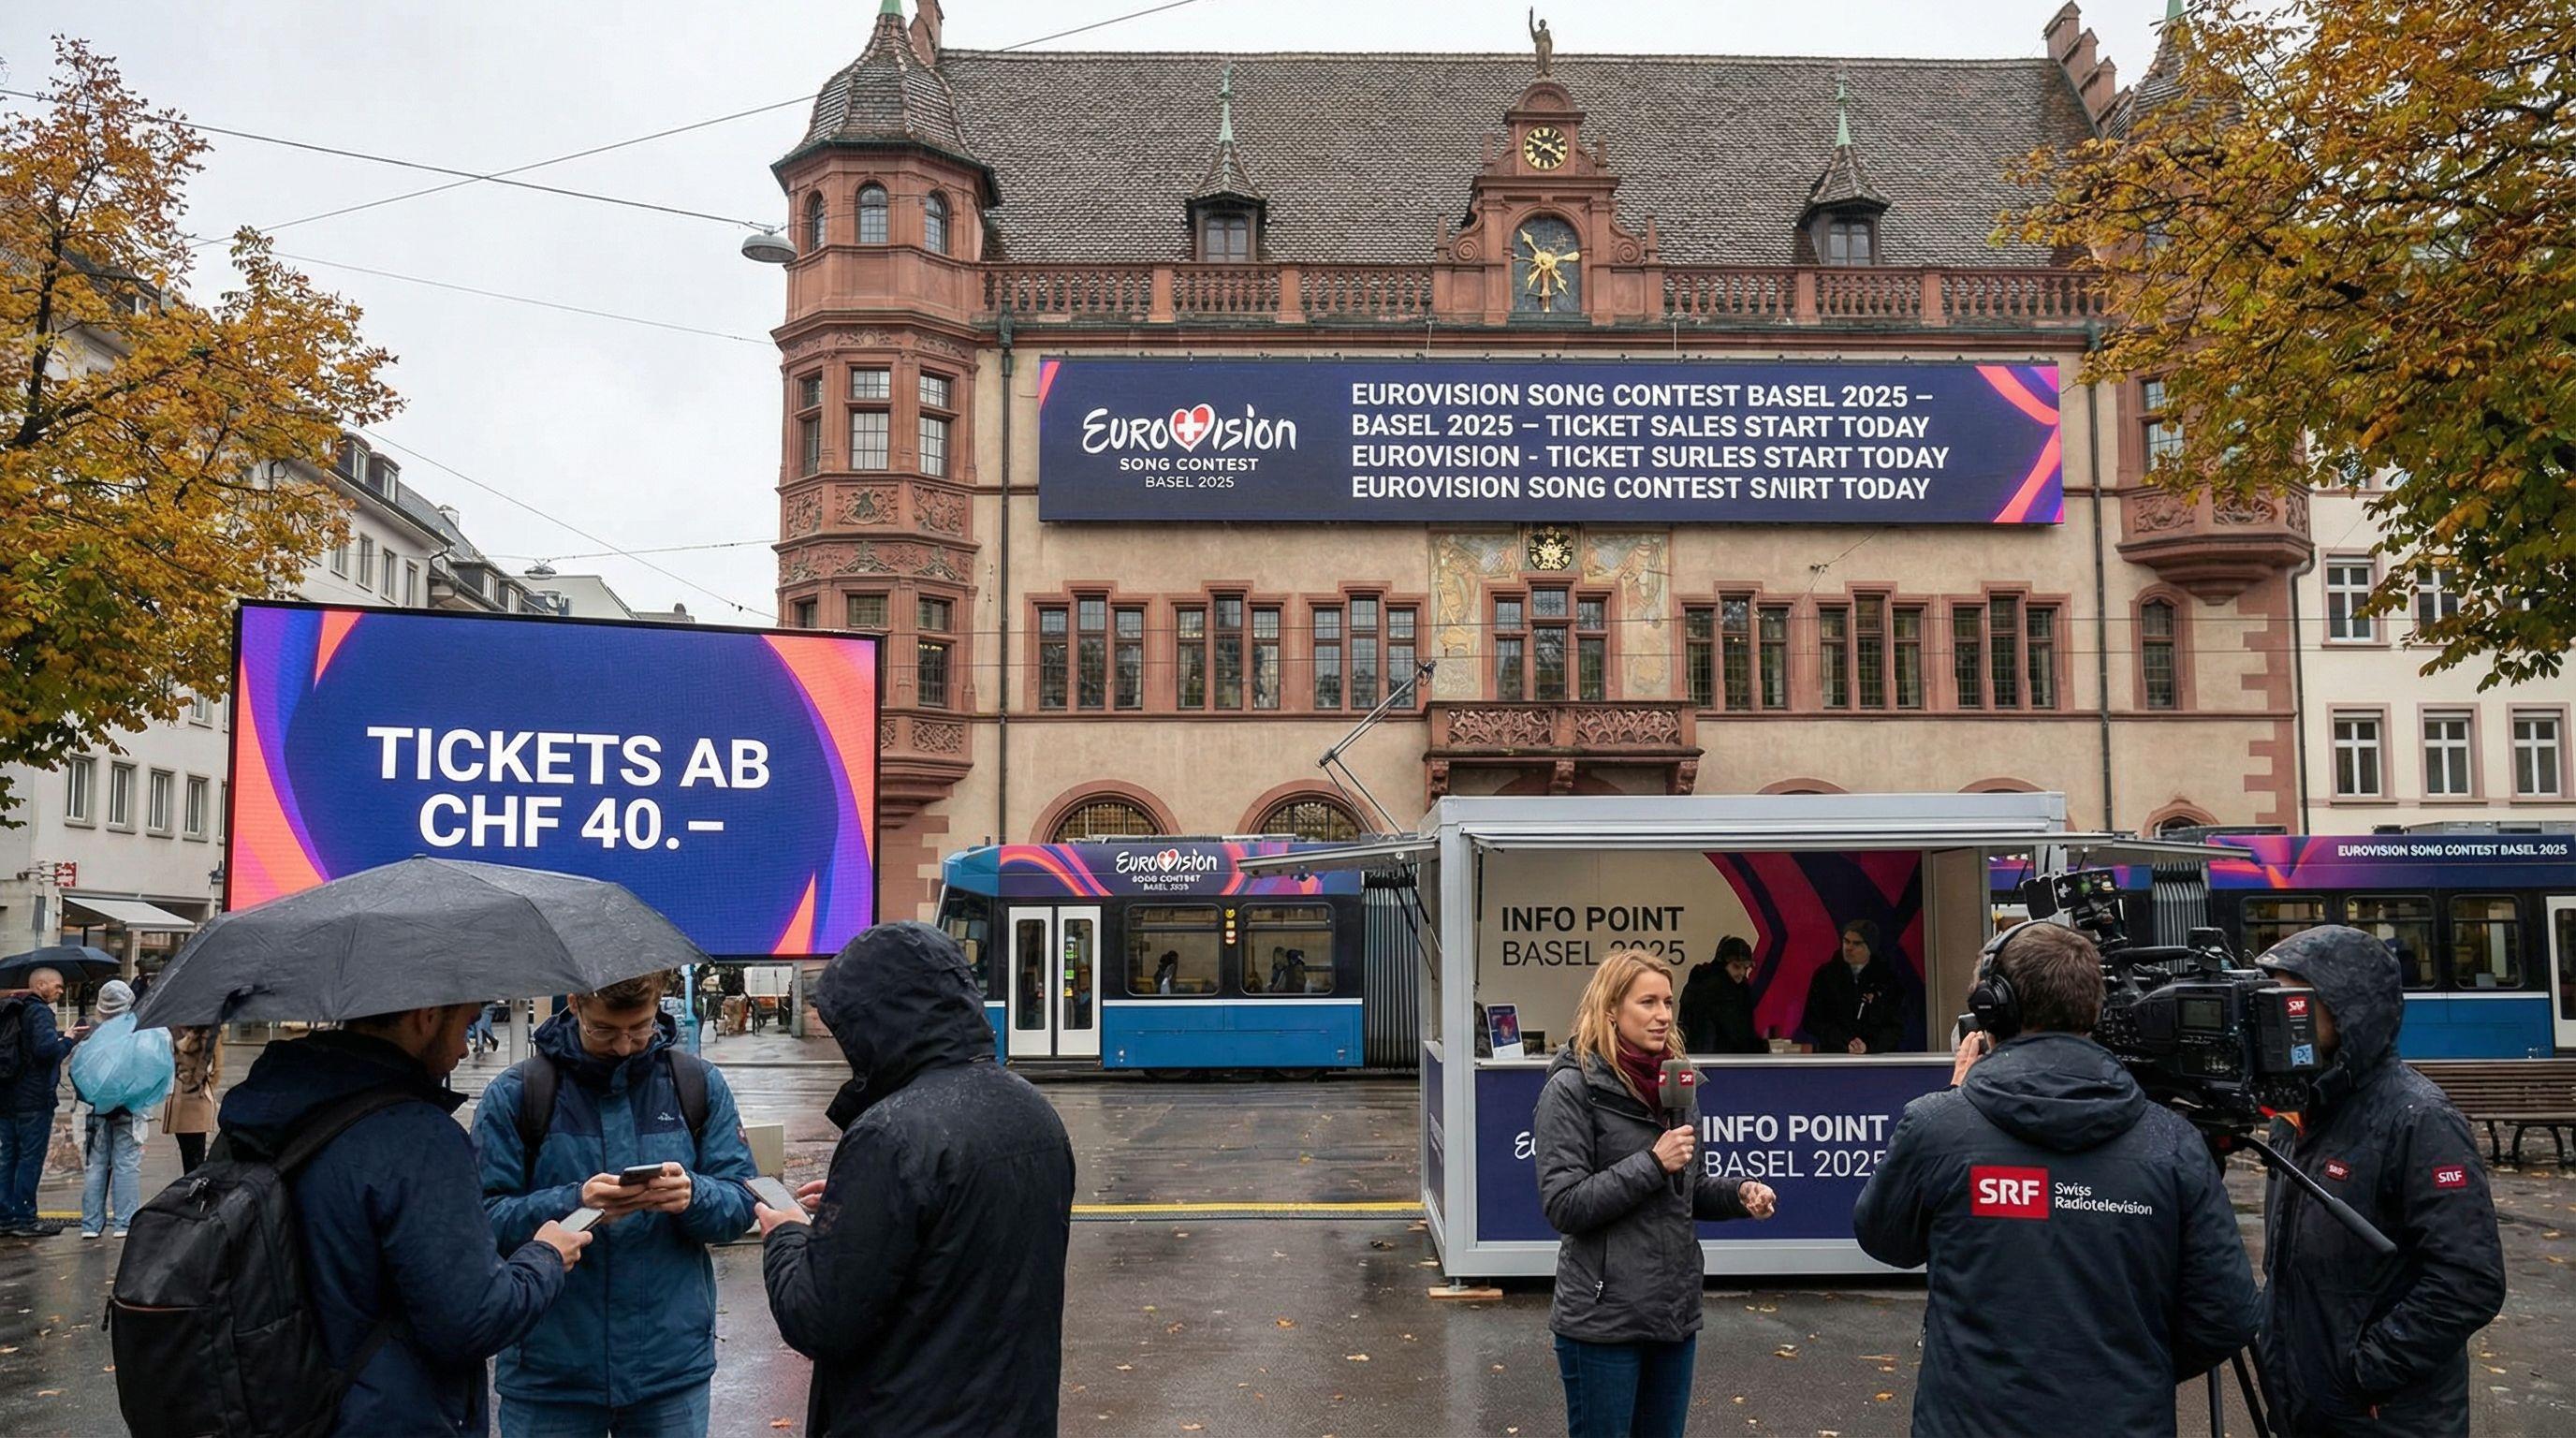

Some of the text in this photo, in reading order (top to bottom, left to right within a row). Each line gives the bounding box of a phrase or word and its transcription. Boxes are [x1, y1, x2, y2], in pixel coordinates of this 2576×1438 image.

[1352, 383, 1519, 406] EUROVISION
[1527, 383, 1604, 406] SONG
[1612, 384, 1741, 407] CONTEST
[1748, 384, 1836, 407] BASEL
[1841, 385, 1909, 408] 2025
[1352, 413, 1441, 436] BASEL
[1447, 414, 1514, 436] 2025
[1545, 414, 1644, 437] TICKET
[1650, 415, 1737, 437] SALES
[1744, 415, 1834, 438] START
[1837, 416, 1930, 438] TODAY
[1120, 457, 1259, 472] SONG CONTEST
[1352, 445, 1520, 467] EUROVISION
[1545, 445, 1645, 468] TICKET
[1651, 446, 1757, 468] SURLES
[1764, 446, 1853, 469] START
[1857, 446, 1950, 469] TODAY
[1145, 476, 1235, 489] BASEL 2025
[1352, 476, 1931, 500] EUROVISION SONG CONTEST SNIRT TODAY
[366, 726, 770, 789] TICKETS AB
[418, 793, 563, 848] CHF
[2337, 844, 2408, 857] EUROVISION
[2445, 844, 2499, 856] CONTEST
[2539, 844, 2569, 856] 2025
[1501, 905, 1685, 932] INFO POINT
[1502, 940, 1600, 966] BASEL
[1702, 1114, 1890, 1143] INFO POINT
[1705, 1150, 1805, 1179] BASEL
[1979, 1178, 2040, 1206] SRF
[2055, 1181, 2092, 1196] Swiss
[2055, 1196, 2153, 1216] Radiotelevision
